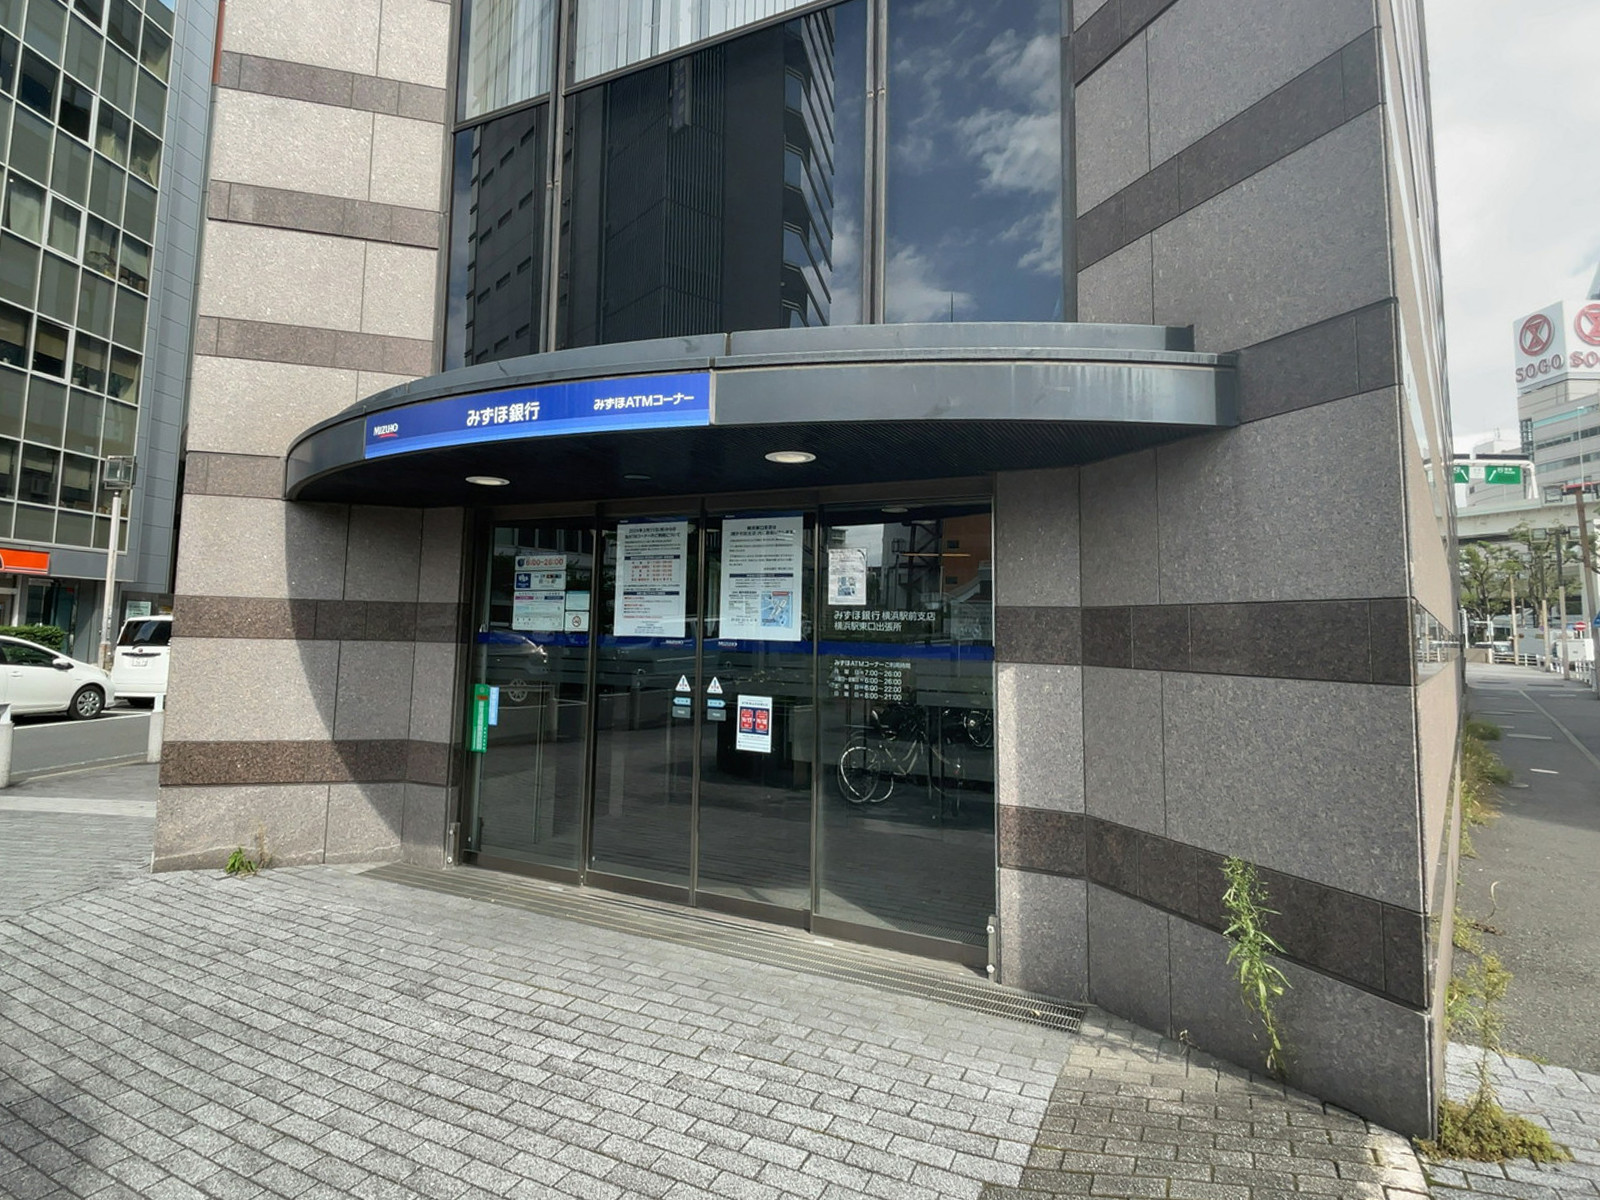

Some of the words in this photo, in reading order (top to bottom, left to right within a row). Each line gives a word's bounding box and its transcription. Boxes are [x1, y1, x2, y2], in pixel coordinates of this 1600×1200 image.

[1569, 351, 1600, 368] SO
[1515, 354, 1564, 383] SOGO
[593, 393, 695, 411] みずほATMコーナー
[466, 401, 540, 427] みずほ銀行
[373, 422, 399, 437] MIZUHO
[833, 610, 880, 620] みずほ銀行
